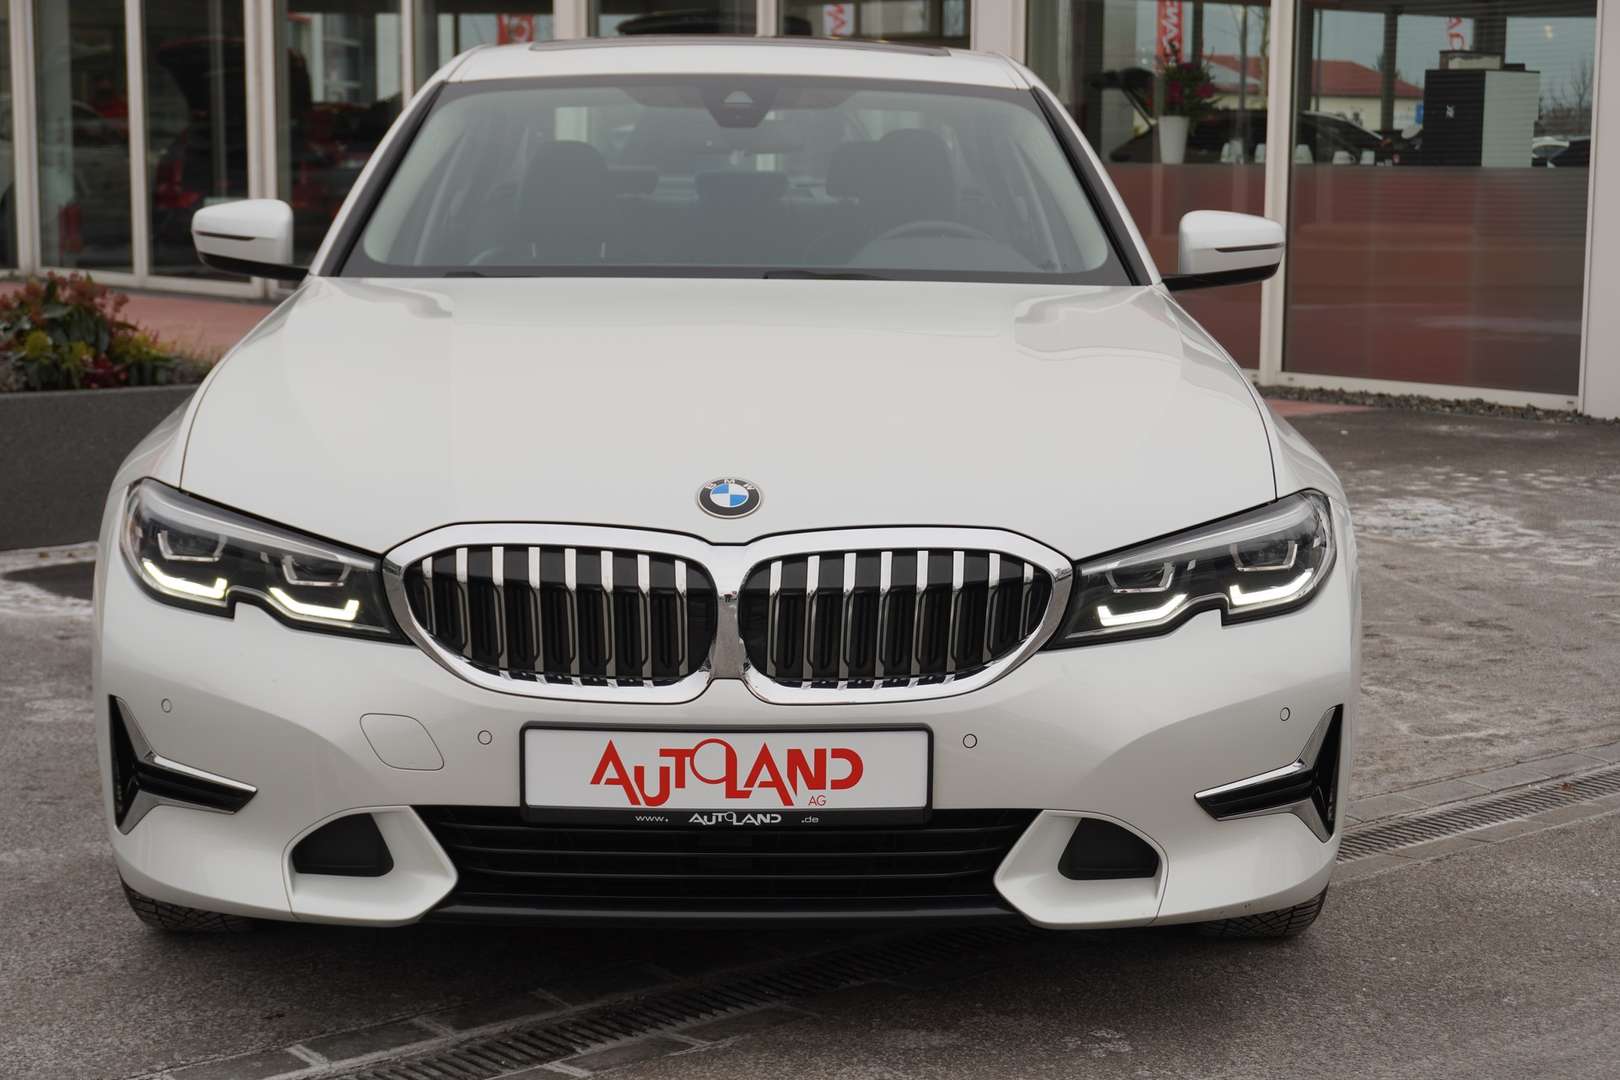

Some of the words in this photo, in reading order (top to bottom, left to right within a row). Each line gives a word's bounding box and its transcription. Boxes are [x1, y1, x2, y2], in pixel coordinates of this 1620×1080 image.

[808, 795, 826, 807] AG
[635, 815, 669, 823] www.
[801, 814, 819, 824] .de
